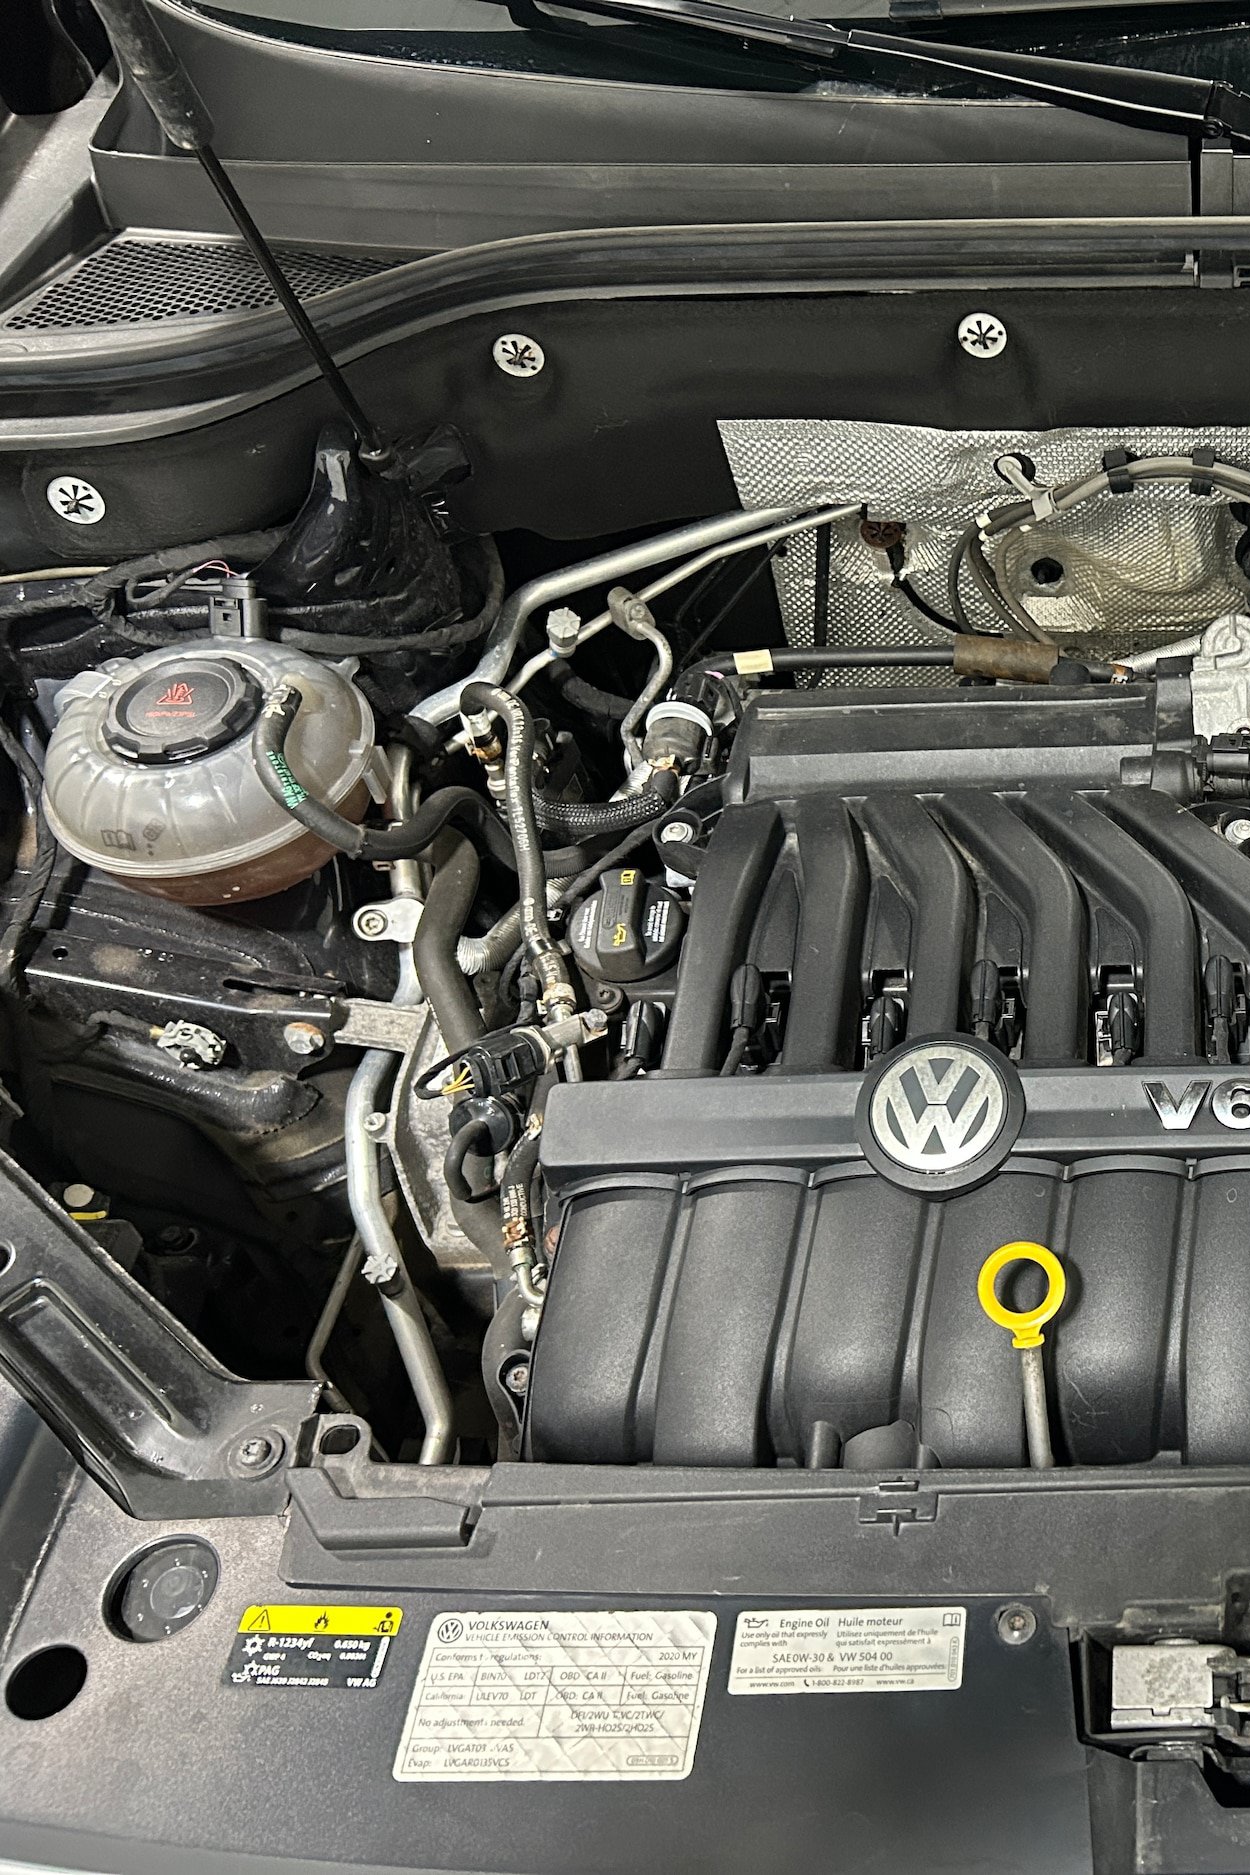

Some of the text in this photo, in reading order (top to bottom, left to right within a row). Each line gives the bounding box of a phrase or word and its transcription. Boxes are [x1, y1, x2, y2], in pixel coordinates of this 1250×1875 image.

[469, 1620, 549, 1631] VOLKSWAGEN
[779, 1617, 829, 1630] Engine Oil
[838, 1617, 903, 1627] Huile moteur
[466, 1632, 653, 1642] VEHICLE EMISSION CONTROL INFORMATION
[755, 1632, 770, 1640] only
[796, 1630, 828, 1639] expressly
[863, 1630, 906, 1638] uniquement
[740, 1640, 771, 1648] complies
[835, 1640, 848, 1648] qui
[848, 1639, 876, 1647] satisfait
[435, 1653, 478, 1662] Conforms
[659, 1652, 681, 1661] 2020
[682, 1651, 698, 1660] MY
[826, 1652, 835, 1662] &
[839, 1652, 858, 1662] VW
[859, 1652, 878, 1661] 504
[880, 1651, 893, 1661] 00
[736, 1666, 748, 1674] For
[775, 1665, 809, 1674] approved
[448, 1672, 464, 1681] EPA
[586, 1671, 599, 1680] CA
[655, 1671, 693, 1680] Gasoline
[362, 1677, 377, 1688] AG
[651, 1691, 690, 1700] Gasoline
[418, 1718, 432, 1727] No
